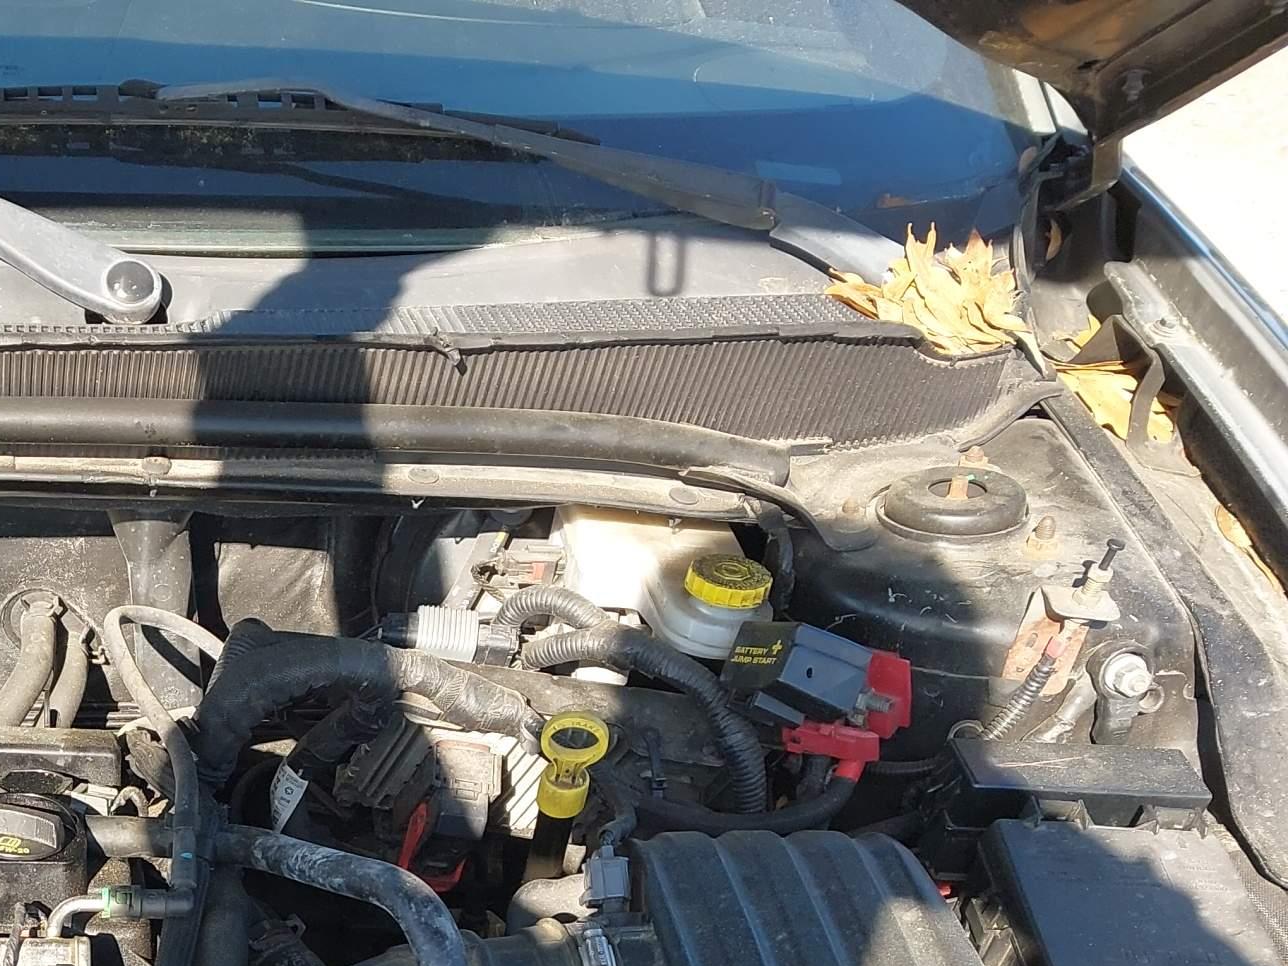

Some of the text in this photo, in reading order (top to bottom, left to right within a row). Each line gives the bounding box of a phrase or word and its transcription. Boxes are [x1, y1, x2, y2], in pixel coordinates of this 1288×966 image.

[735, 646, 769, 656] BATTERY
[731, 655, 777, 665] JUMP START
